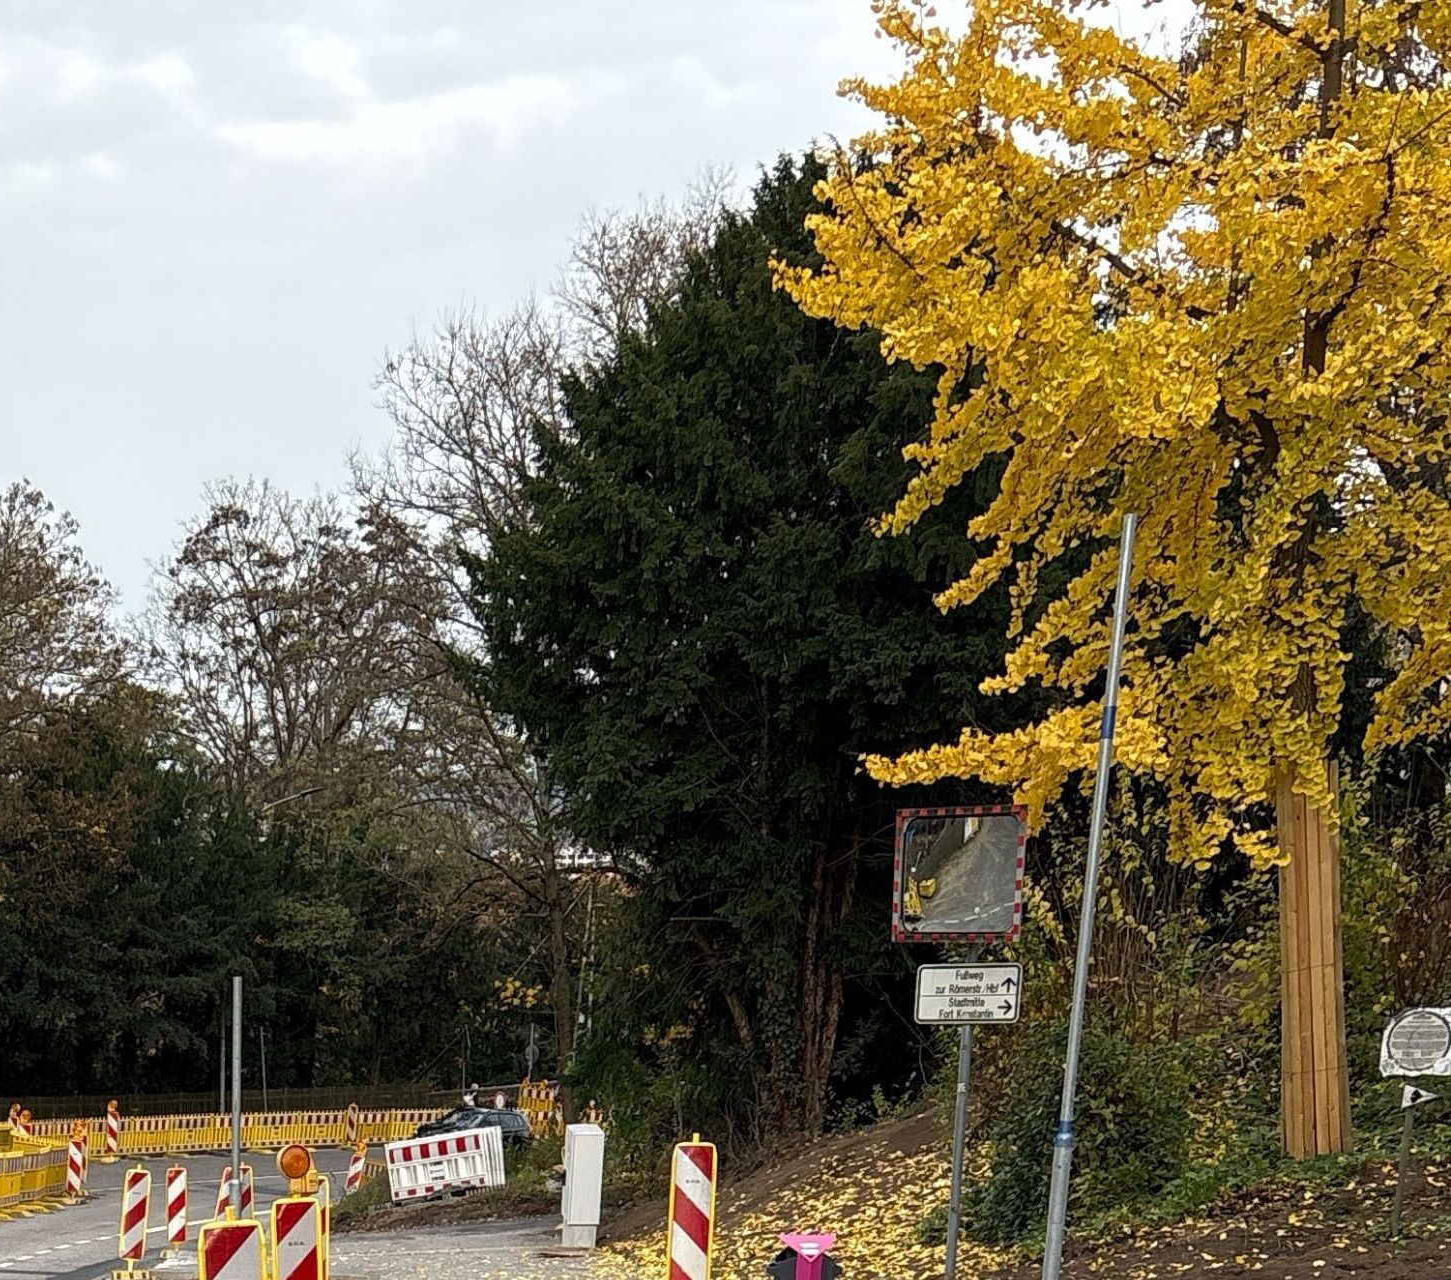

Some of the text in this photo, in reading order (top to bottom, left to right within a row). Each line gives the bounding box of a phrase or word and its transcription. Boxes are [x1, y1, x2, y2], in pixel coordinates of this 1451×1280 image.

[955, 970, 984, 981] Fußweg
[935, 986, 946, 994] zur
[948, 998, 985, 1007] Stadtmitte
[938, 1009, 954, 1018] Fort
